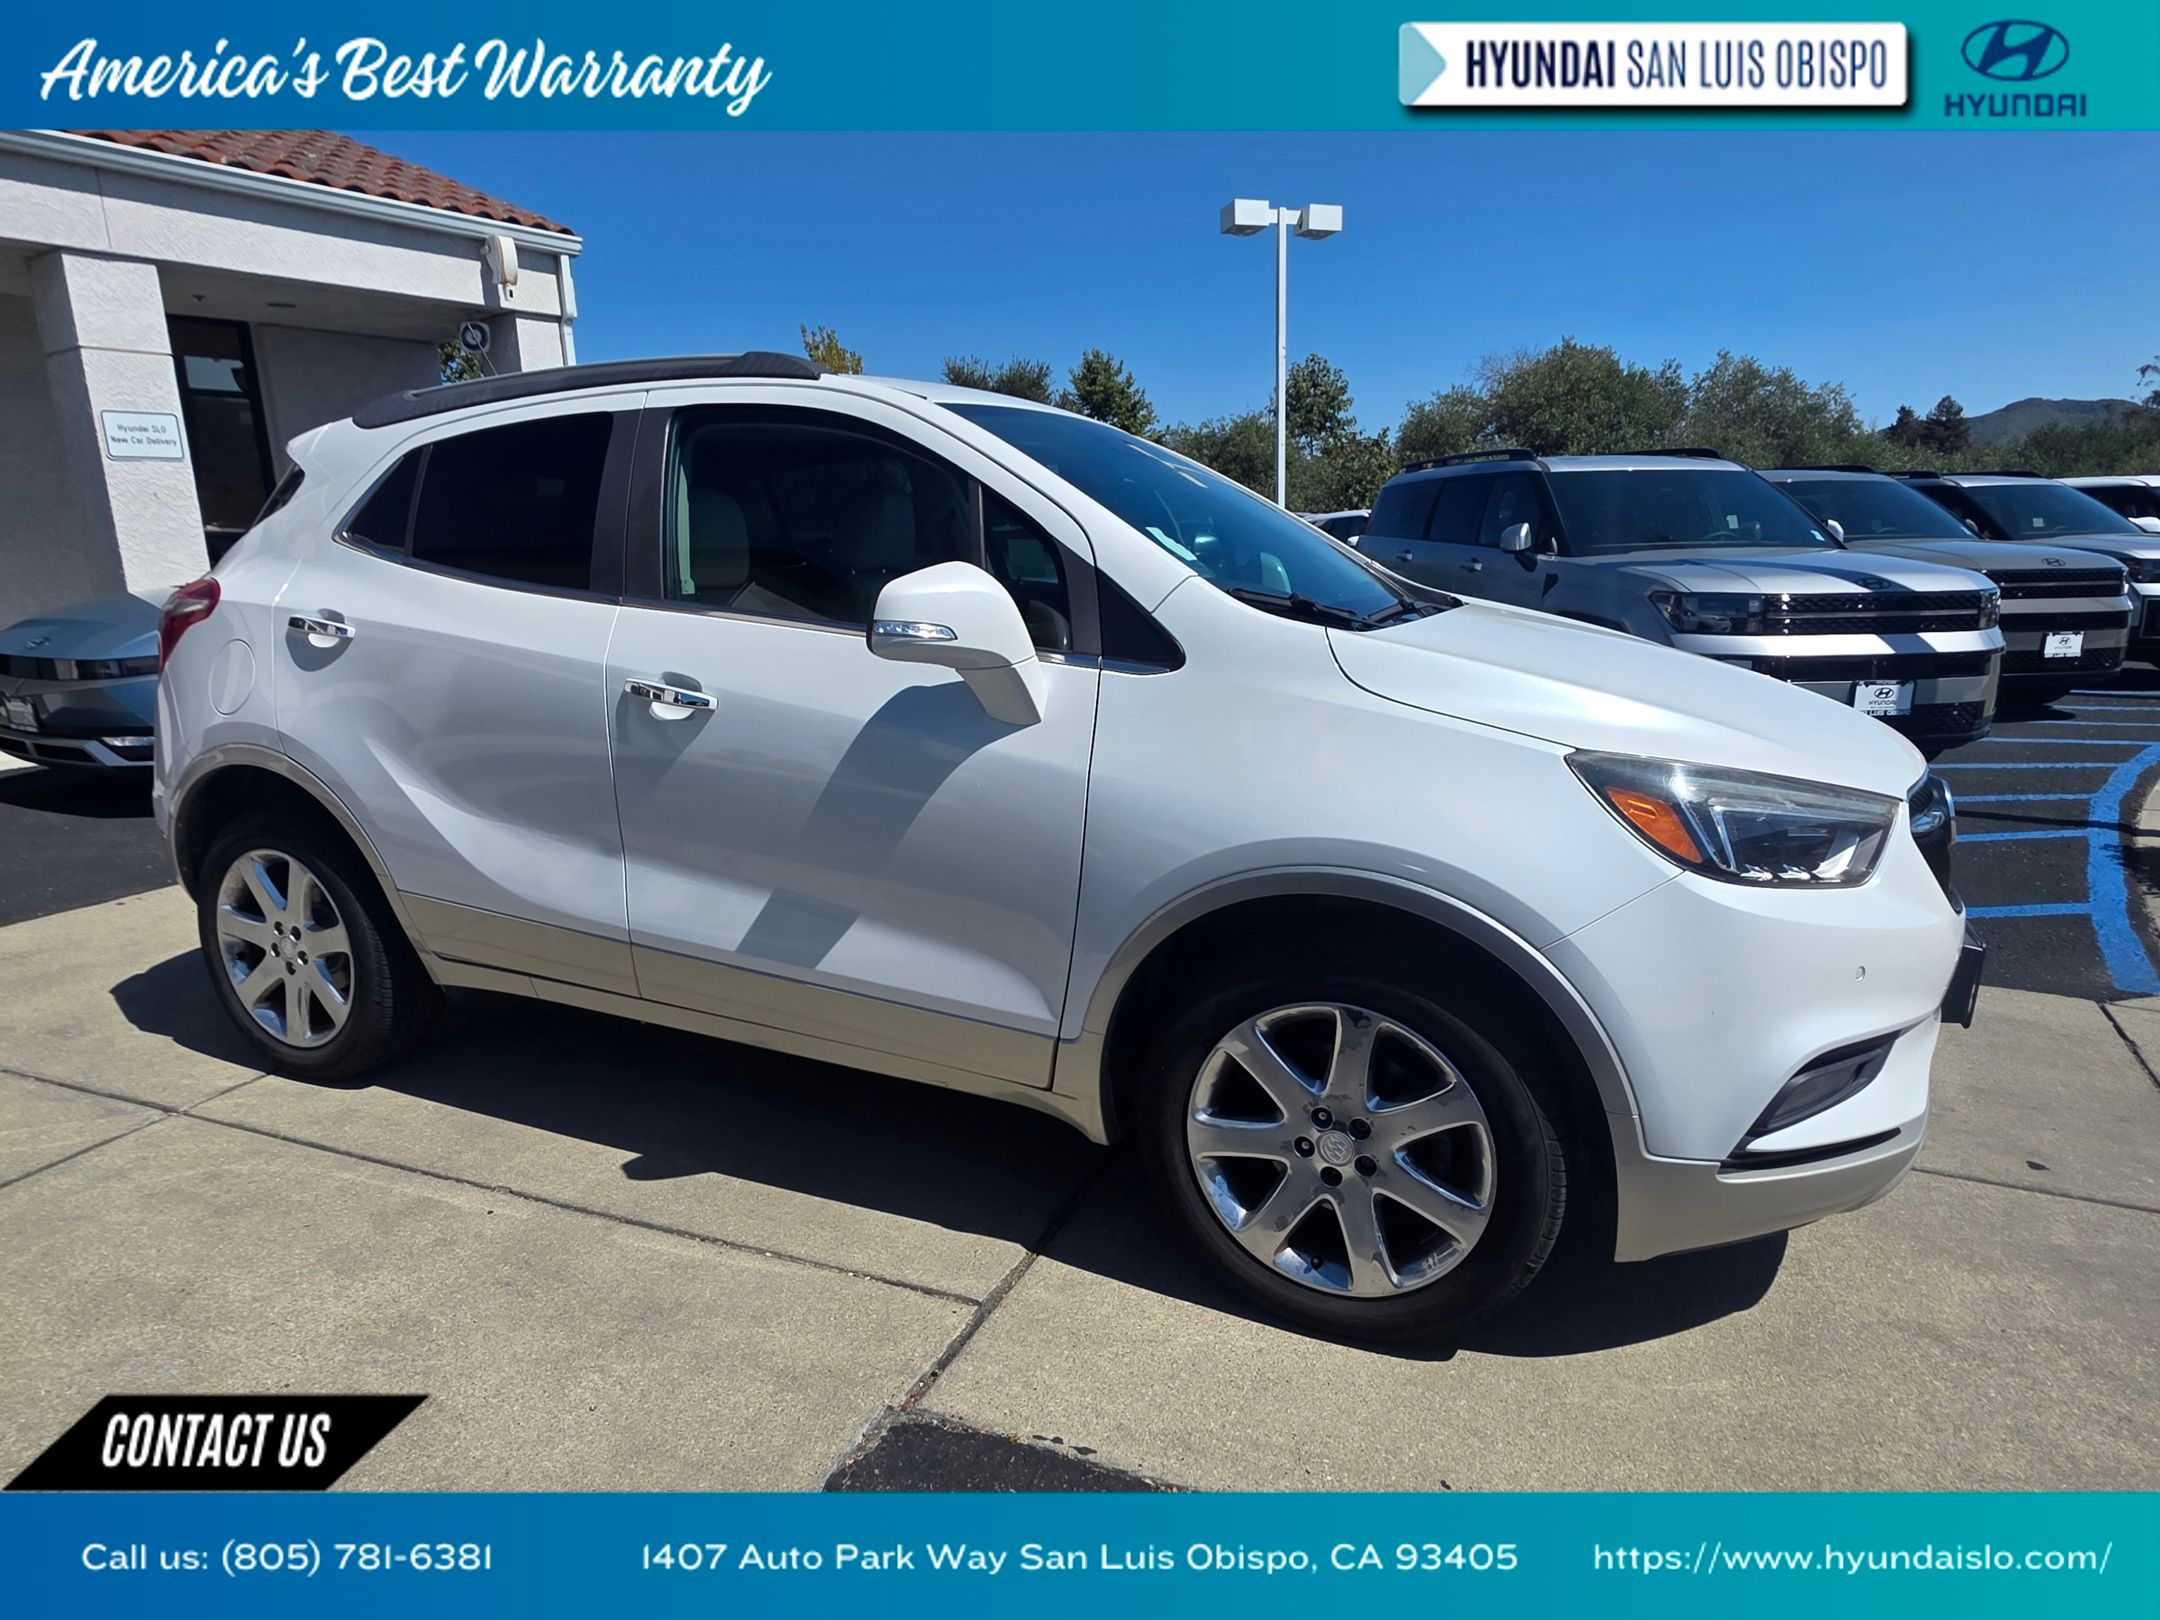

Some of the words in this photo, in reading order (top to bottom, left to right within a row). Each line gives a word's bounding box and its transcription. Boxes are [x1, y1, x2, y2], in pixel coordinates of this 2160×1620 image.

[117, 424, 149, 433] Hyundai
[151, 424, 167, 434] SLO
[110, 435, 128, 444] New
[130, 435, 144, 444] Car
[146, 436, 177, 446] Delivery
